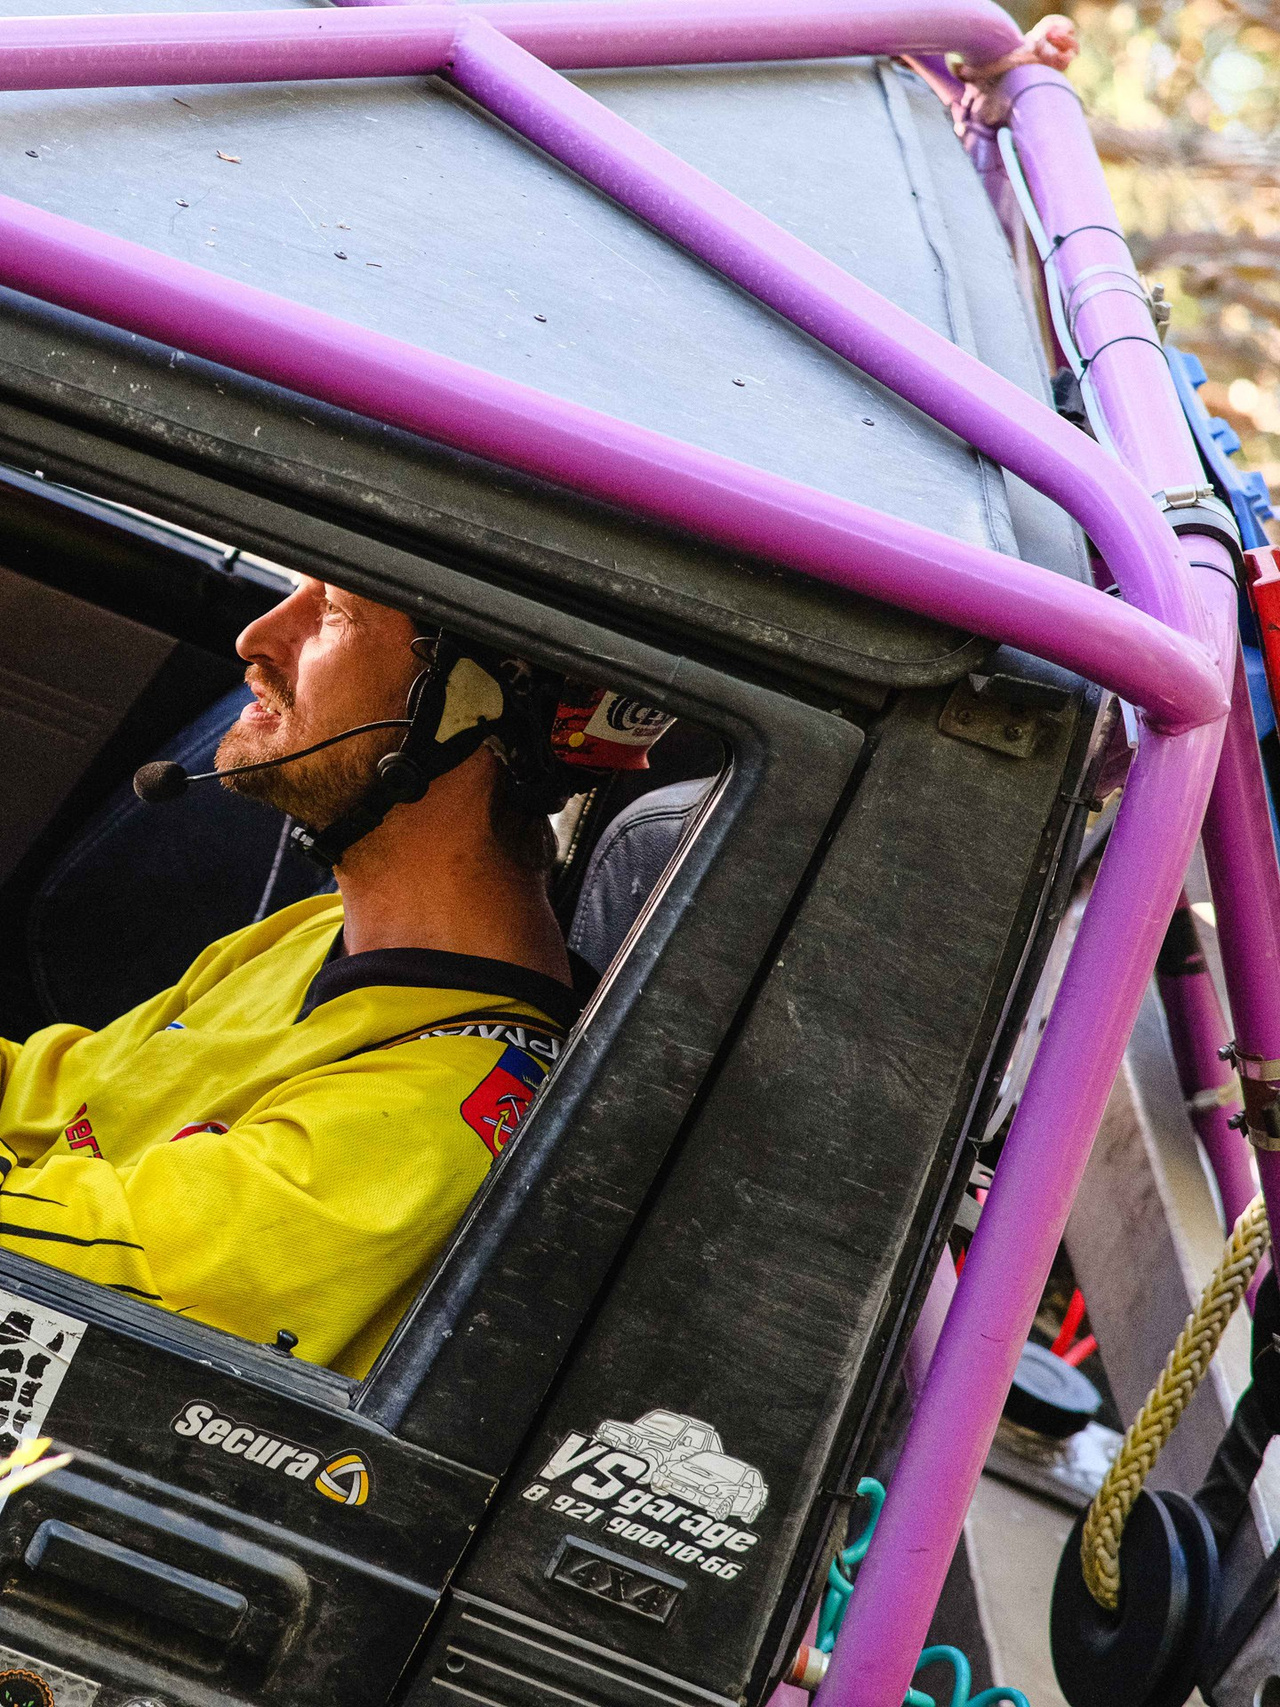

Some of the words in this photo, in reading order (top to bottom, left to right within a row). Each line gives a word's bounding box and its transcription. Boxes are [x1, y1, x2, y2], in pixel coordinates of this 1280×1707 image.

[174, 1404, 320, 1481] Secura
[522, 1484, 550, 1501] 8
[550, 1494, 604, 1524] 921
[539, 1432, 650, 1501] VS
[612, 1488, 758, 1553] garage
